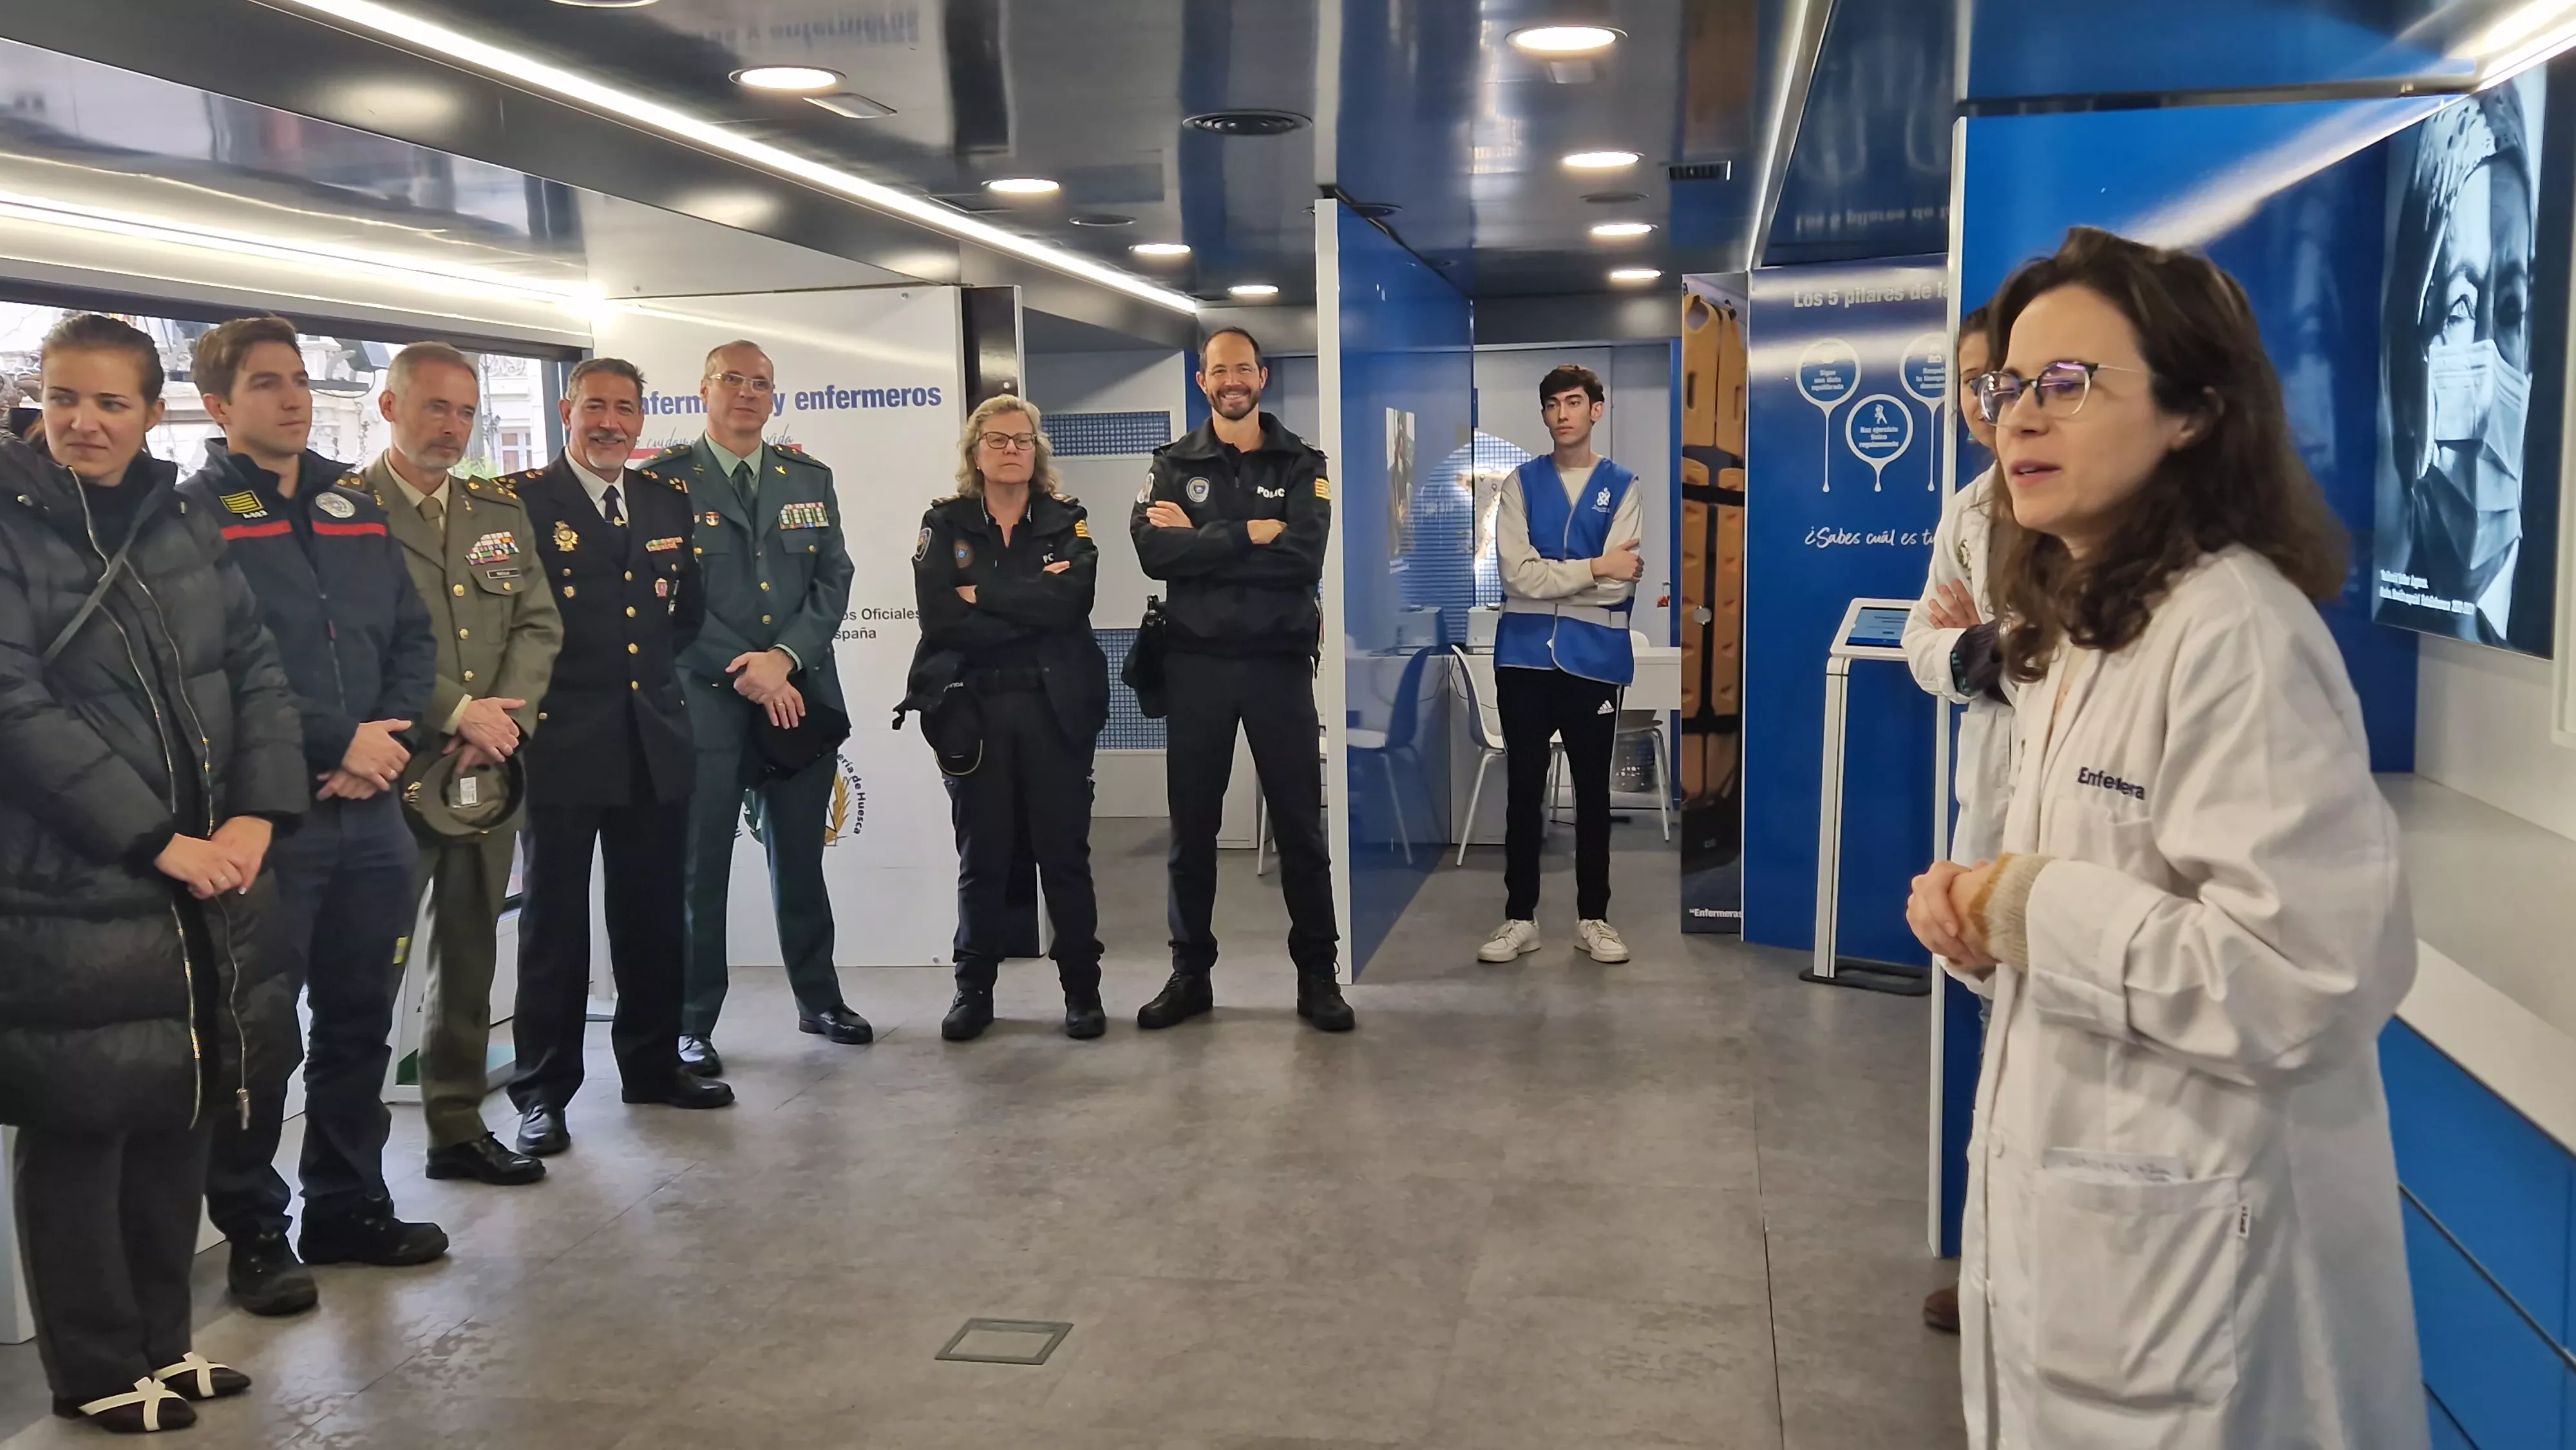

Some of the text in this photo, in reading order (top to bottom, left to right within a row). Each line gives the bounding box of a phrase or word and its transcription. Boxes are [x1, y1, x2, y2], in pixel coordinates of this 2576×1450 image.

[1794, 292, 1824, 308] Los
[1828, 289, 1839, 306] 5
[1844, 287, 1904, 308] pilares
[1909, 283, 1932, 301] de
[773, 392, 786, 417] y
[794, 384, 942, 411] enfermeros
[766, 423, 794, 444] vida
[1256, 485, 1285, 498] POLIC
[1804, 525, 1861, 549] ¿Sabes
[1866, 529, 1896, 547] cuál
[1900, 532, 1918, 546] es
[834, 626, 877, 642] spaña
[837, 753, 867, 834] ería de Huesca
